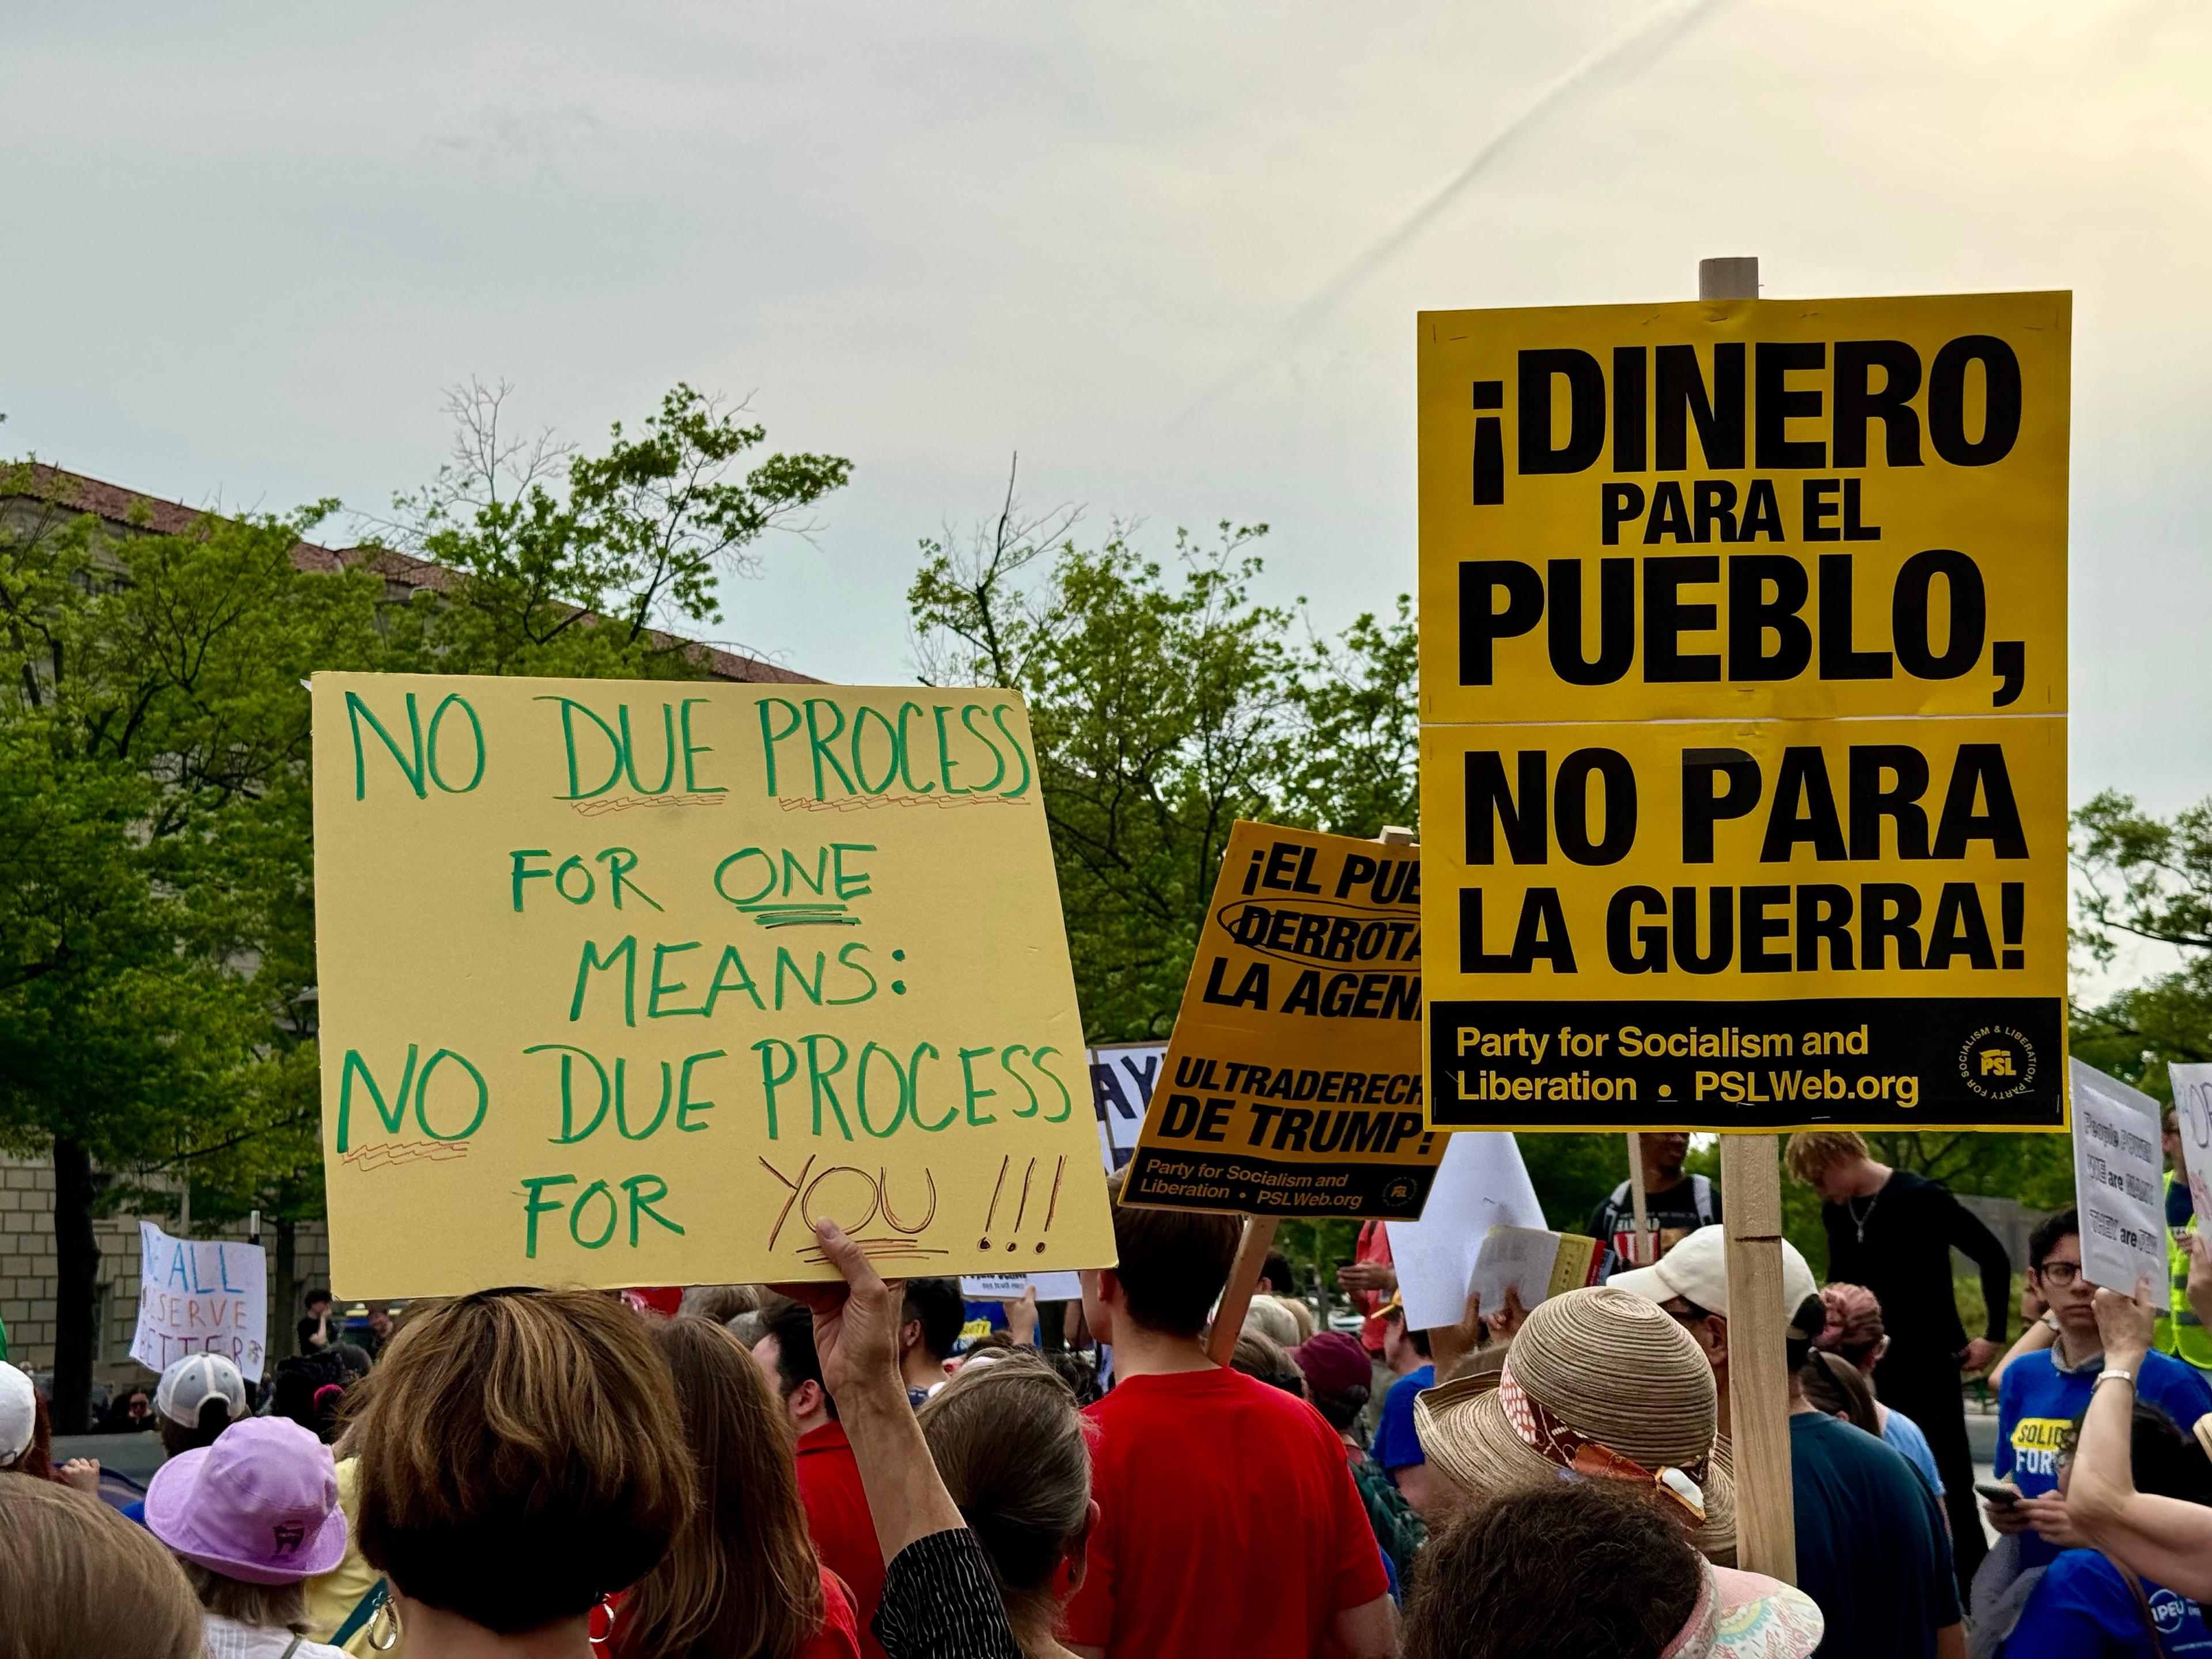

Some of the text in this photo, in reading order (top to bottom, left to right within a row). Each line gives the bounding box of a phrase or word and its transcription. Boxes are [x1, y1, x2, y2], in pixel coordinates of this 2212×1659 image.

[1473, 334, 2022, 505] ¡DINERO
[1602, 478, 1881, 546] PARA EL
[1459, 549, 2025, 708] PUEBLO,
[346, 691, 1031, 801] NO DUE PROCESS
[1464, 743, 2030, 866] NO PARA
[510, 843, 877, 912] FOR ONE
[1241, 842, 1322, 896] ¡EL
[1459, 882, 2025, 975] LA GUERRA!
[569, 935, 907, 1028] MEANS:
[1203, 957, 1270, 1011] LA
[1457, 1024, 1868, 1065] Party for Socialism and
[1959, 1025, 2037, 1100] PARTY FOR SOCIALISM & LIBERATION
[1980, 1057, 2016, 1076] PSL
[337, 1033, 1072, 1153] NO DUE PROCESS
[1457, 1069, 1919, 1108] Liberation PSLWeb.org
[1157, 1093, 1435, 1155] DE TRUMP!
[1139, 1178, 1231, 1199] Liberation
[1256, 1189, 1363, 1210] PSLWeb.org
[1146, 1158, 1195, 1179] Party
[1198, 1163, 1224, 1179] for
[1226, 1165, 1312, 1188] Socialism
[1315, 1173, 1349, 1187] and
[2108, 1171, 2123, 1191] are
[521, 1154, 1067, 1259] FOR YOU !!!
[2120, 1228, 2137, 1248] are
[168, 1242, 245, 1294] ALL
